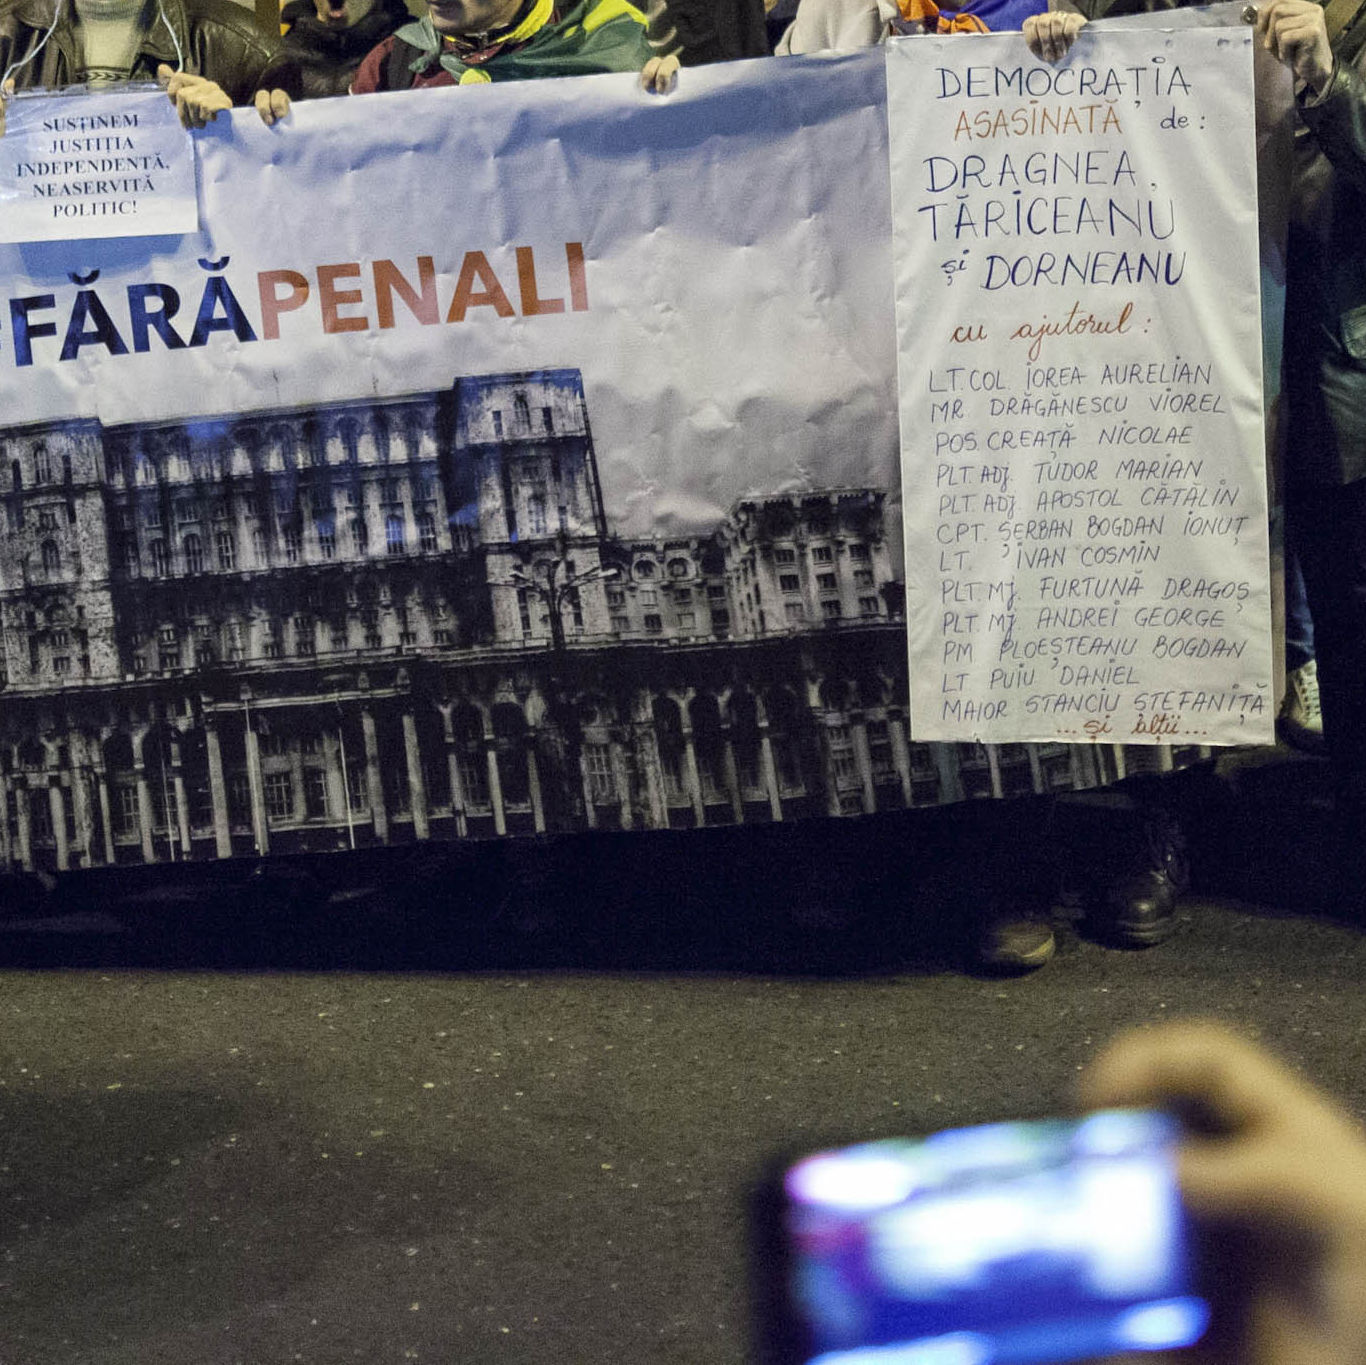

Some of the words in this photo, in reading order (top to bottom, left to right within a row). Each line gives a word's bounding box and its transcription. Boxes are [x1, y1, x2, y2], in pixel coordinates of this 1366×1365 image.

[934, 55, 1193, 110] DEMOCRAȚIA
[42, 113, 139, 133] SUSȚINEM
[953, 97, 1125, 142] ASASINATĂ
[49, 136, 135, 155] JUSTIȚIA
[16, 152, 171, 178] INDEPENDENTĂ,
[33, 175, 156, 198] NEASERVITĂ
[52, 200, 138, 218] POLITIC!
[917, 189, 1177, 243] TĂRICEANU
[941, 248, 972, 287] și
[980, 250, 1188, 291] DORNEANU
[949, 322, 988, 344] cu
[1100, 355, 1212, 385] AURELIAN
[990, 391, 1129, 418] DRĂGĂNESCU
[1149, 387, 1226, 414] VIOREL
[1098, 419, 1194, 445] NICOLAE
[1034, 459, 1099, 484] TUDOR
[1115, 453, 1204, 481] MARIAN
[1036, 487, 1124, 513] APOSTOL
[1140, 479, 1241, 508] CĂTĂLIN
[1087, 514, 1166, 539] BOGDAN
[1183, 510, 1250, 546] IONUȚ
[1016, 542, 1067, 570] IVAN
[1081, 540, 1161, 567] COSMIN
[1040, 569, 1145, 600] FURTUNĂ
[1161, 577, 1251, 614] DRAGOȘ
[1036, 600, 1121, 630] ANDREI
[1134, 606, 1226, 628] GEORGE
[999, 635, 1139, 670] PLOEȘTEANU
[1152, 634, 1249, 659] BOGDAN
[990, 663, 1036, 690] PUIU
[1059, 657, 1141, 686] DANIEL
[942, 699, 1008, 723] MAIOR
[1025, 687, 1121, 714] STANCIU
